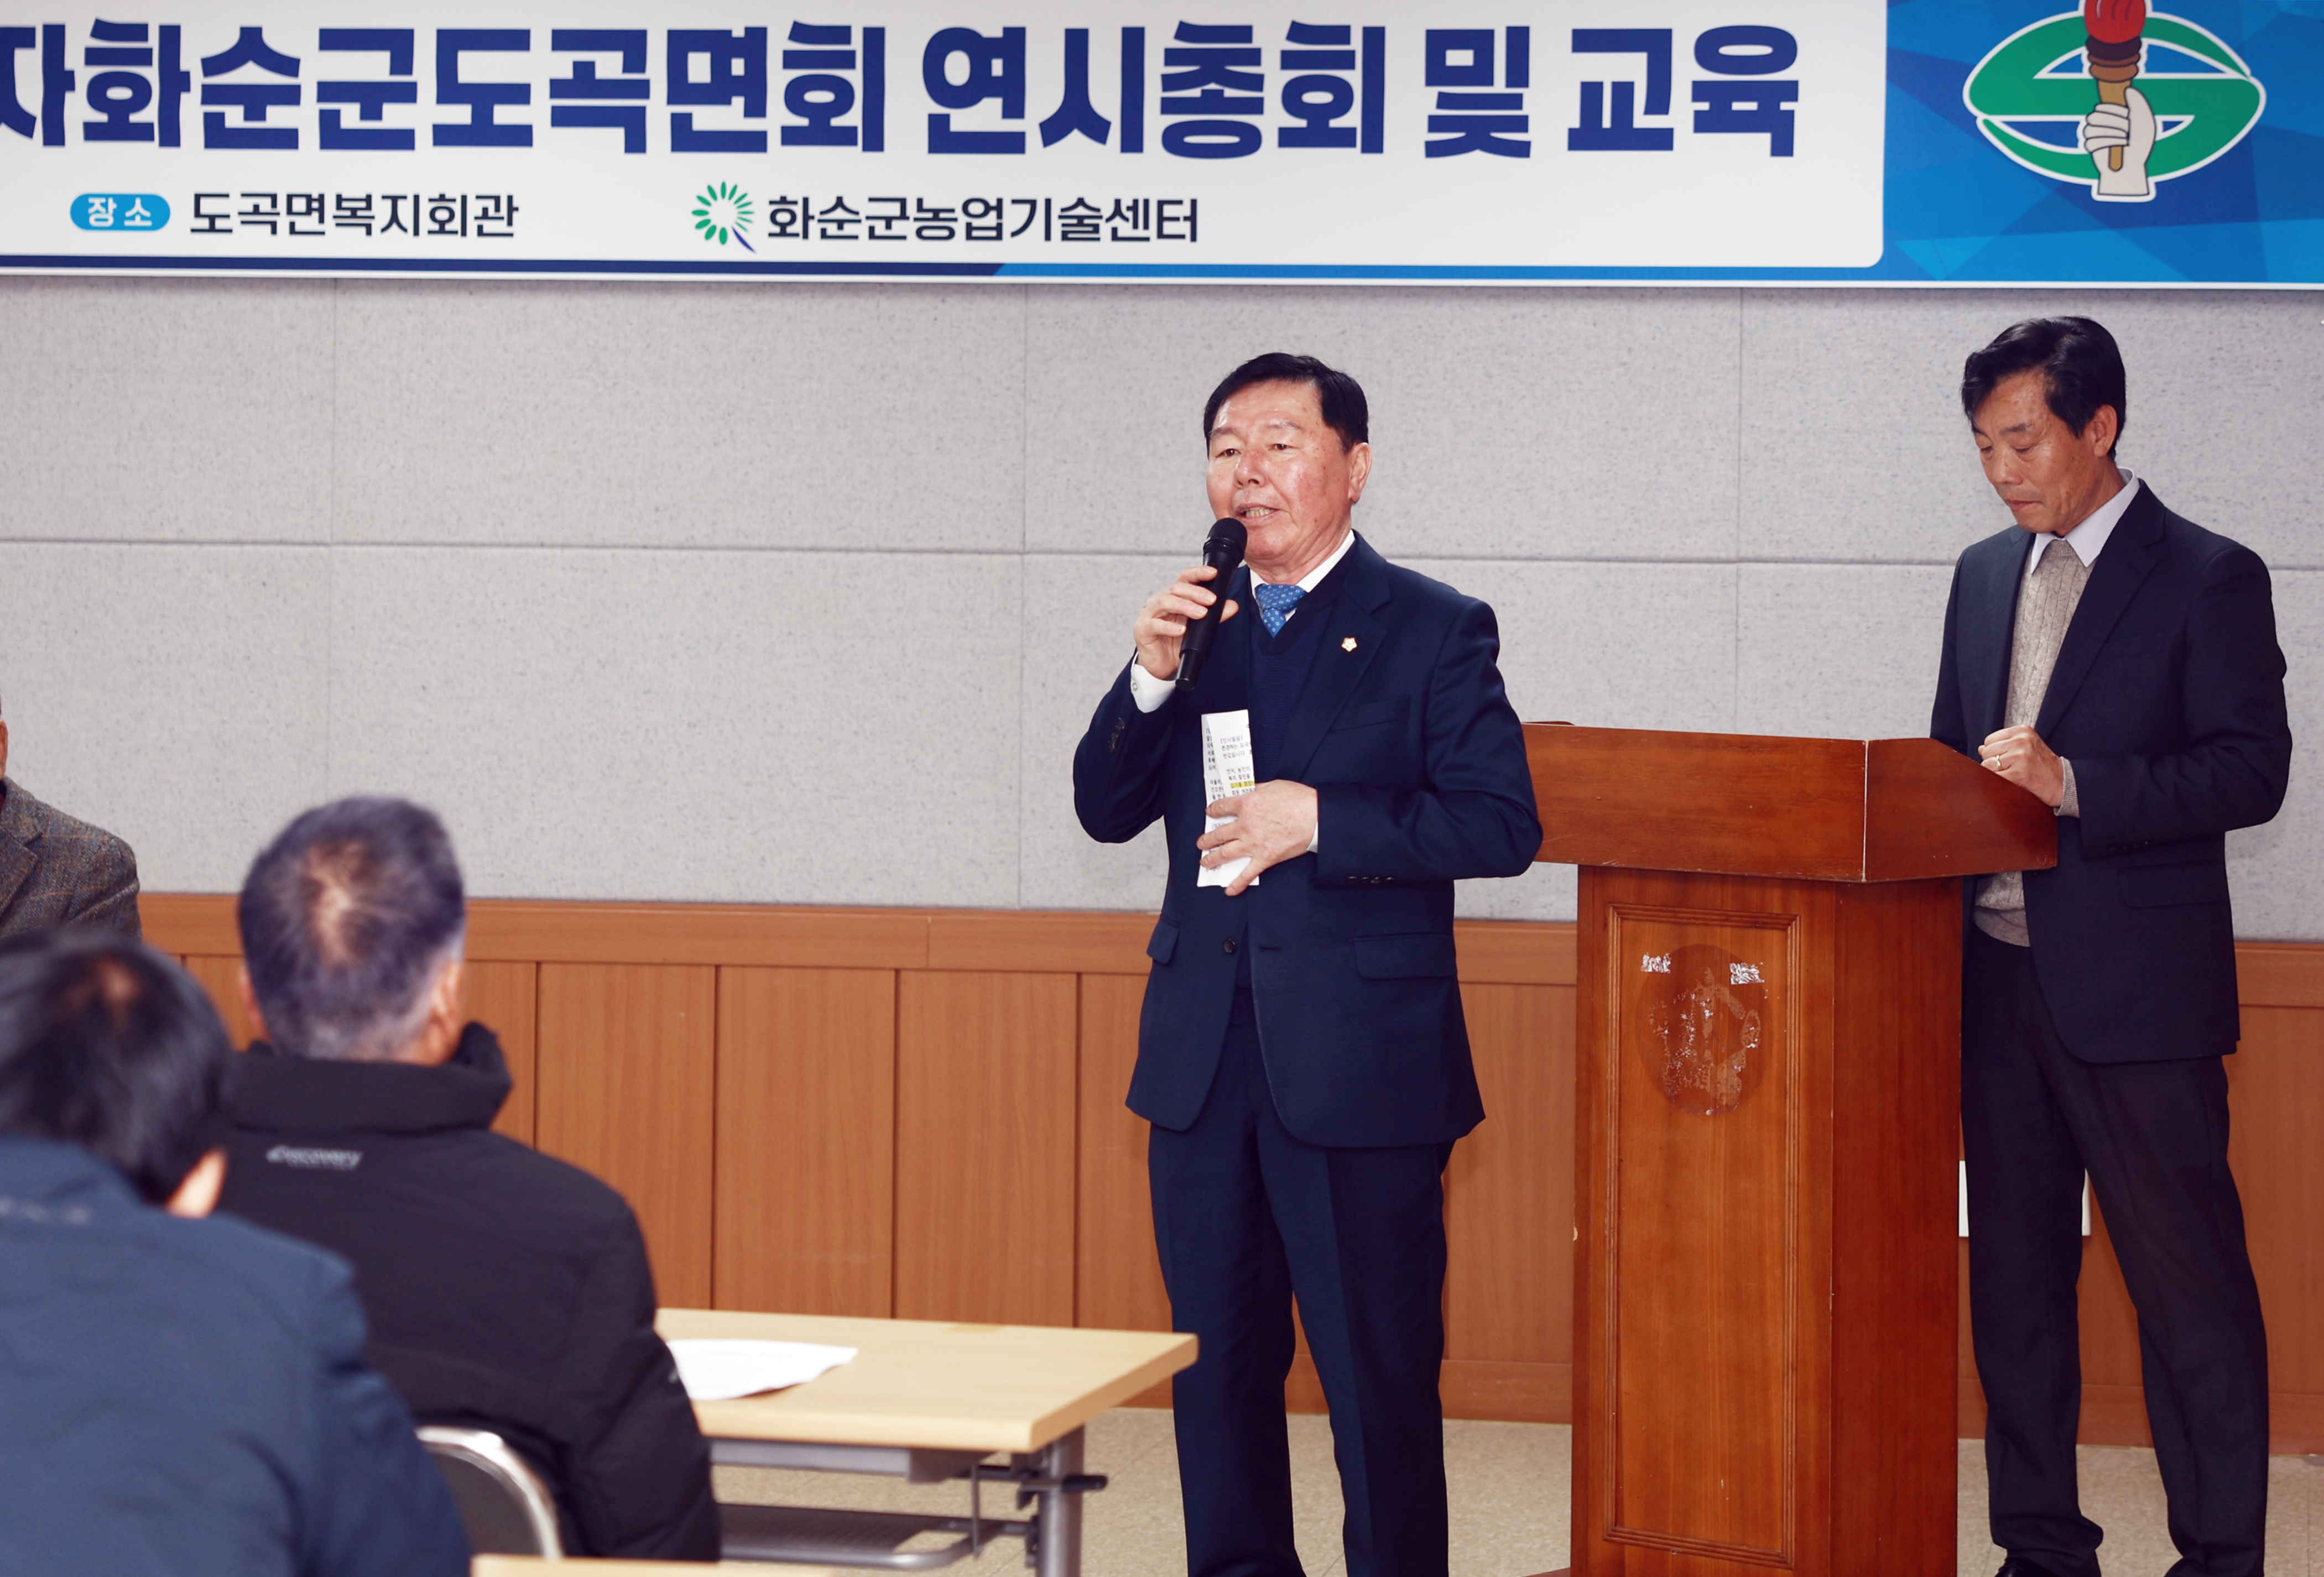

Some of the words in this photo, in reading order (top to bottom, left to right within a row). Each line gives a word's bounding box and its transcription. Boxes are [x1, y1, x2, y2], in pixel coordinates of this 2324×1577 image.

[923, 20, 1385, 159] 연시총회
[1425, 26, 1531, 158] 및
[1568, 25, 1799, 156] 교육
[191, 194, 518, 237] 도곡면복지회관
[768, 196, 1197, 242] 화순군농업기술센터
